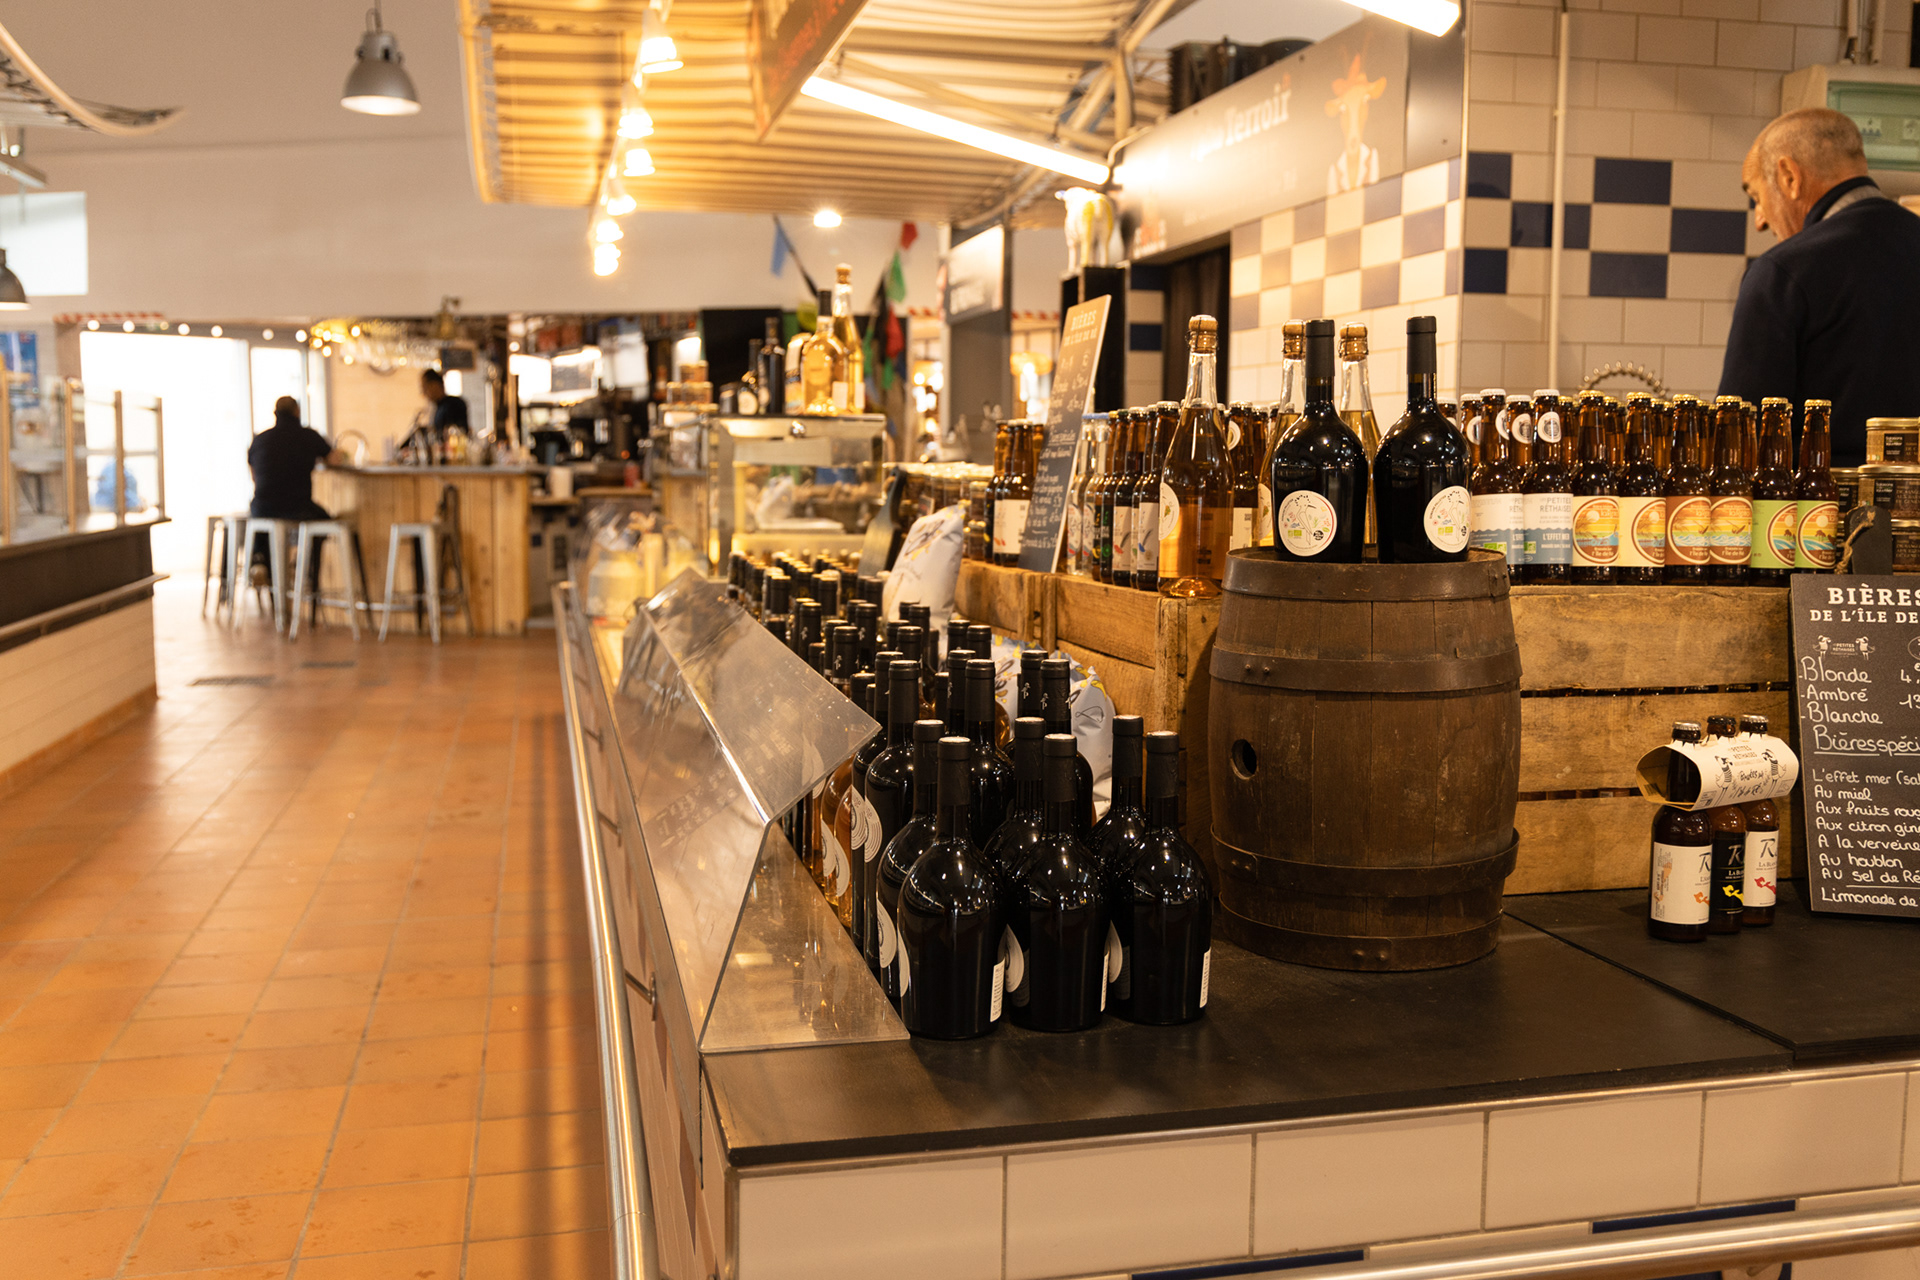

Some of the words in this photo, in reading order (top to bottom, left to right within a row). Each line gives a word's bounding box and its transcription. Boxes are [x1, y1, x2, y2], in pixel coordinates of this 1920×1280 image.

[1810, 609, 1833, 622] DE
[1840, 607, 1887, 623] L'ÎLE
[1895, 611, 1919, 623] DE
[1800, 655, 1872, 683] Blonde
[1807, 683, 1869, 702] Ambré
[1807, 700, 1884, 725] Blanche
[1812, 768, 1860, 783] L'effet
[1865, 774, 1891, 784] mer
[1814, 784, 1833, 798] Au
[1838, 787, 1873, 801] miel
[1815, 801, 1841, 815] Aux
[1846, 801, 1890, 816] fruits
[1815, 816, 1843, 830] Aux
[1848, 820, 1892, 832] citron
[1818, 834, 1829, 848] A
[1836, 834, 1854, 848] la
[1857, 839, 1920, 851] verveine
[1819, 852, 1841, 866] Au
[1848, 853, 1903, 869] houblon
[1821, 867, 1843, 880] Au
[1852, 869, 1874, 882] sel
[1880, 871, 1899, 883] de
[1821, 887, 1897, 906] Limonade
[1899, 895, 1919, 907] de
